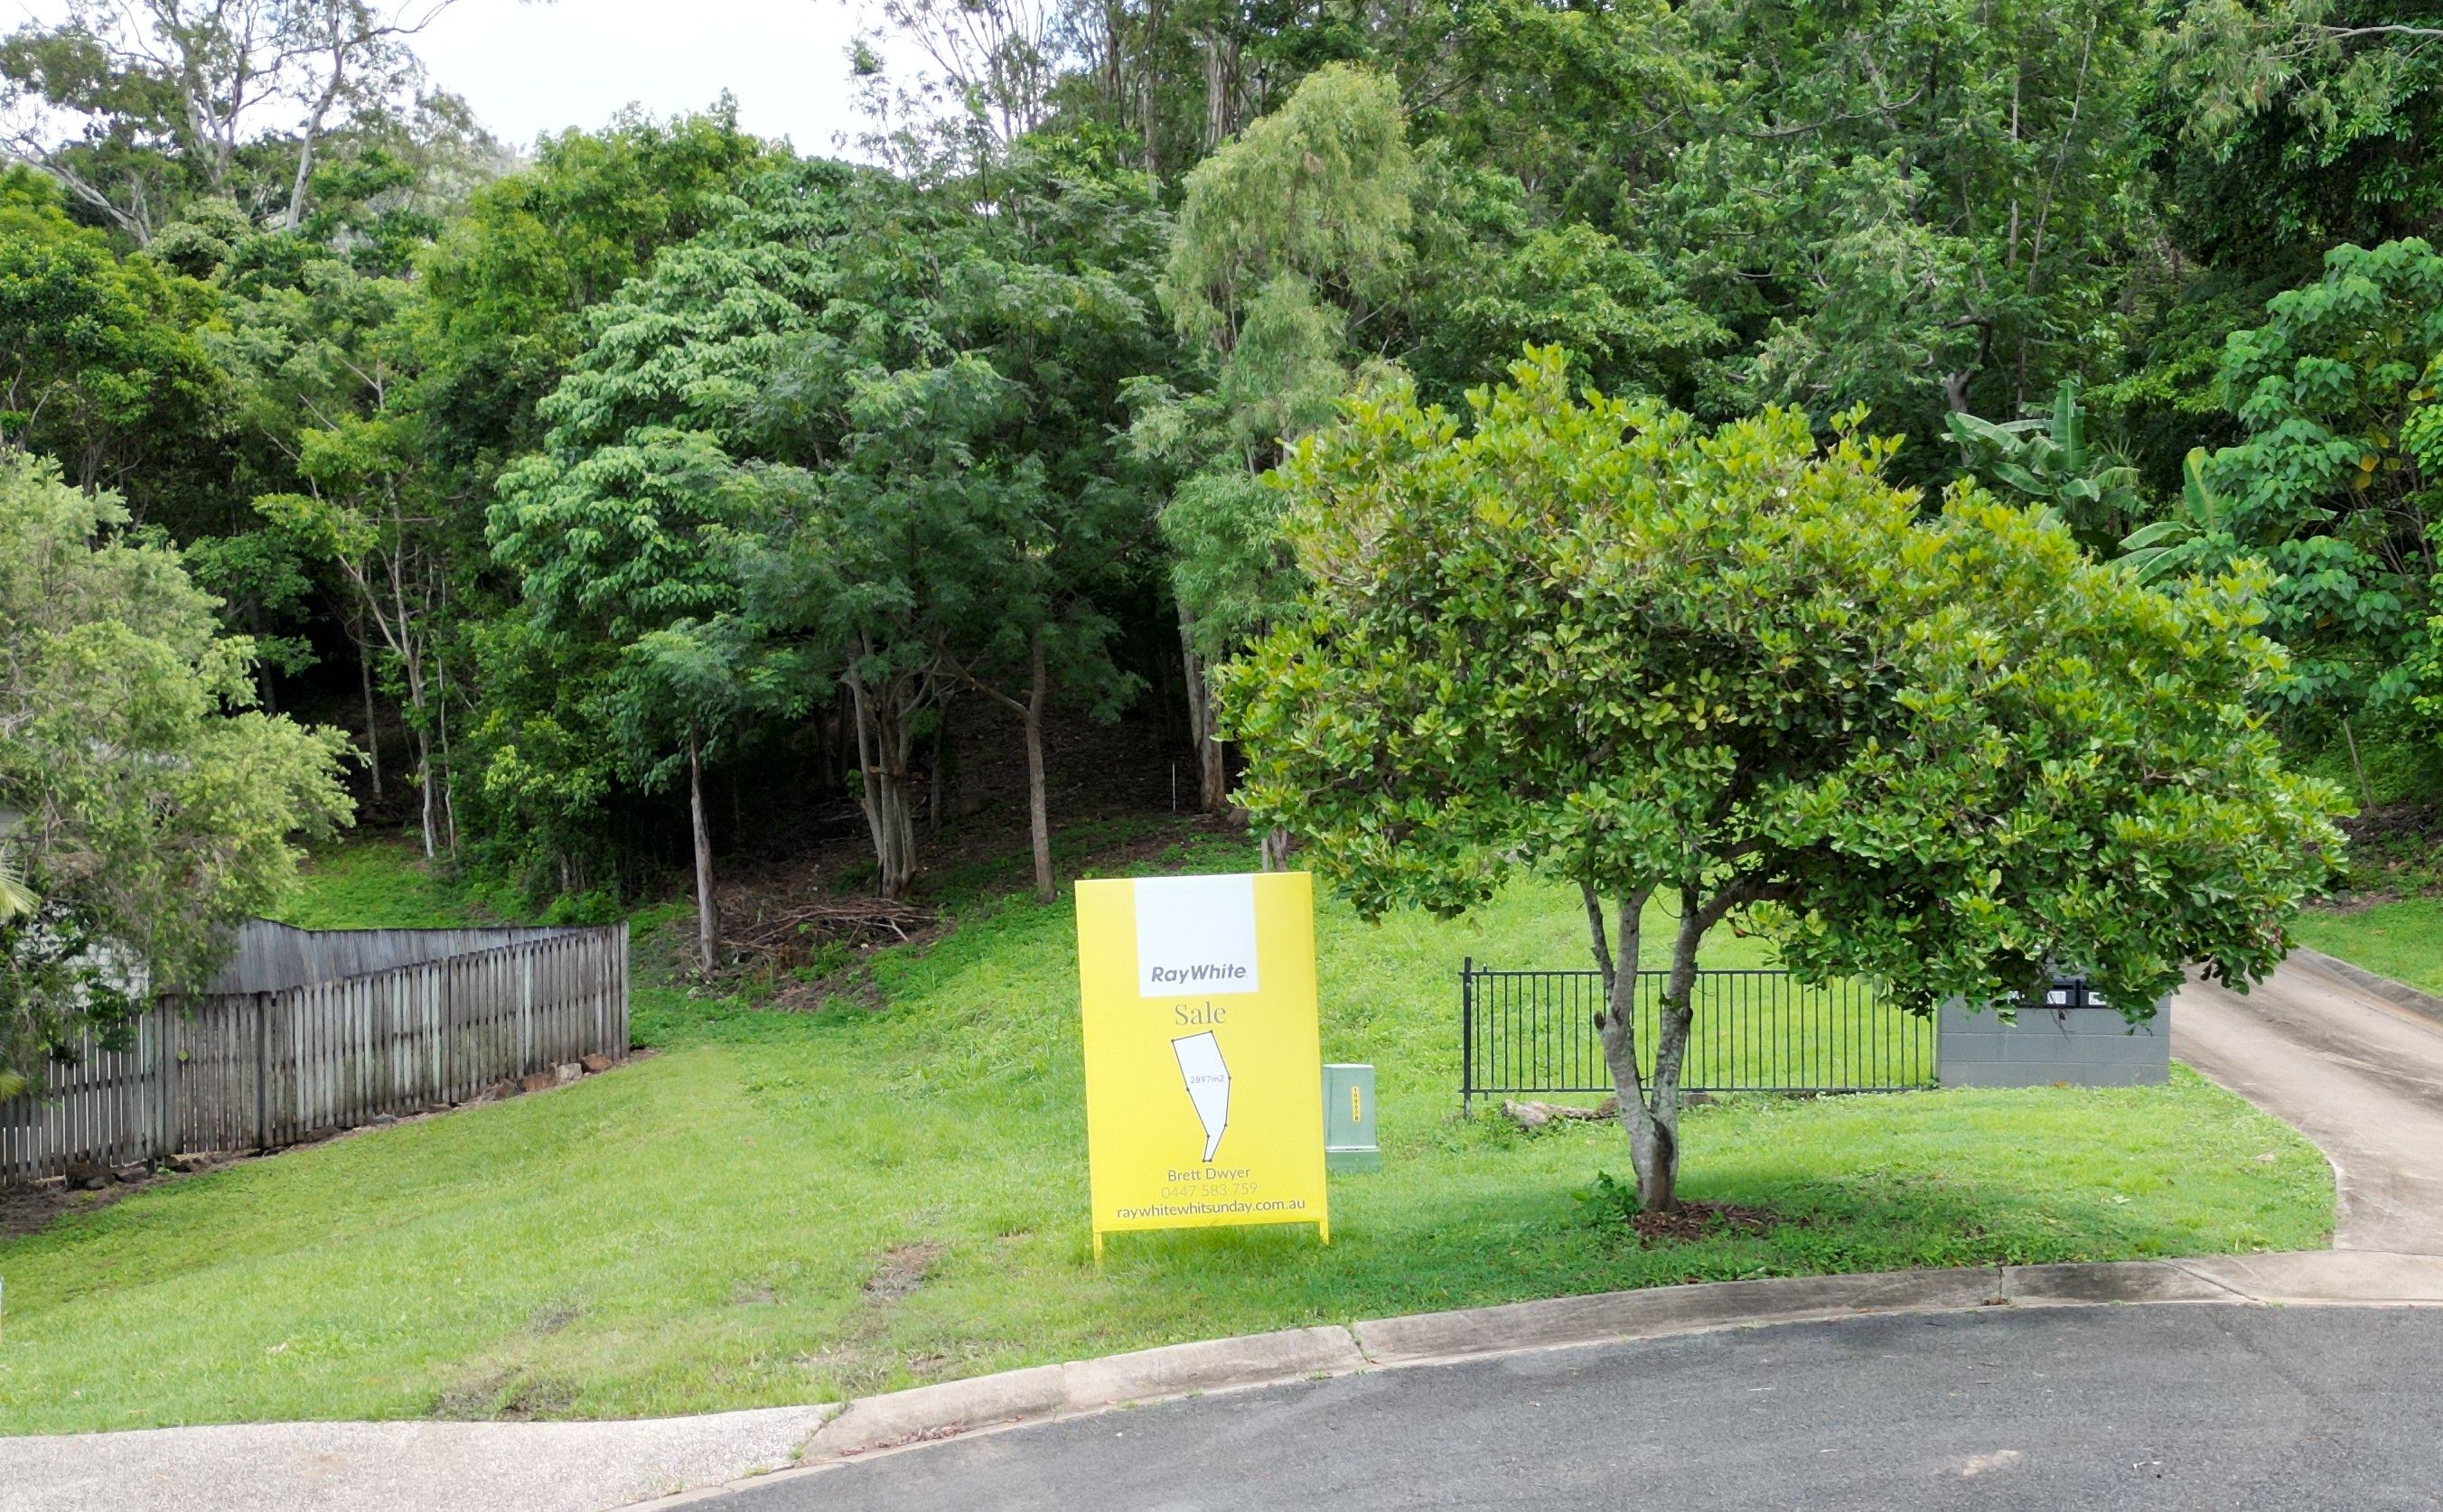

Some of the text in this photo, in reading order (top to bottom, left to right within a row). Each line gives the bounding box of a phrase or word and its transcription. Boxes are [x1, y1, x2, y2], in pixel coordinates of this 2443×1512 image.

[1175, 1001, 1227, 1026] Sale
[1190, 1074, 1223, 1084] 2897m2
[1167, 1167, 1251, 1182] Brett Dwyer
[1161, 1181, 1258, 1199] 0447 583 759
[1117, 1199, 1306, 1219] raywhitewhitsunday.com.au
